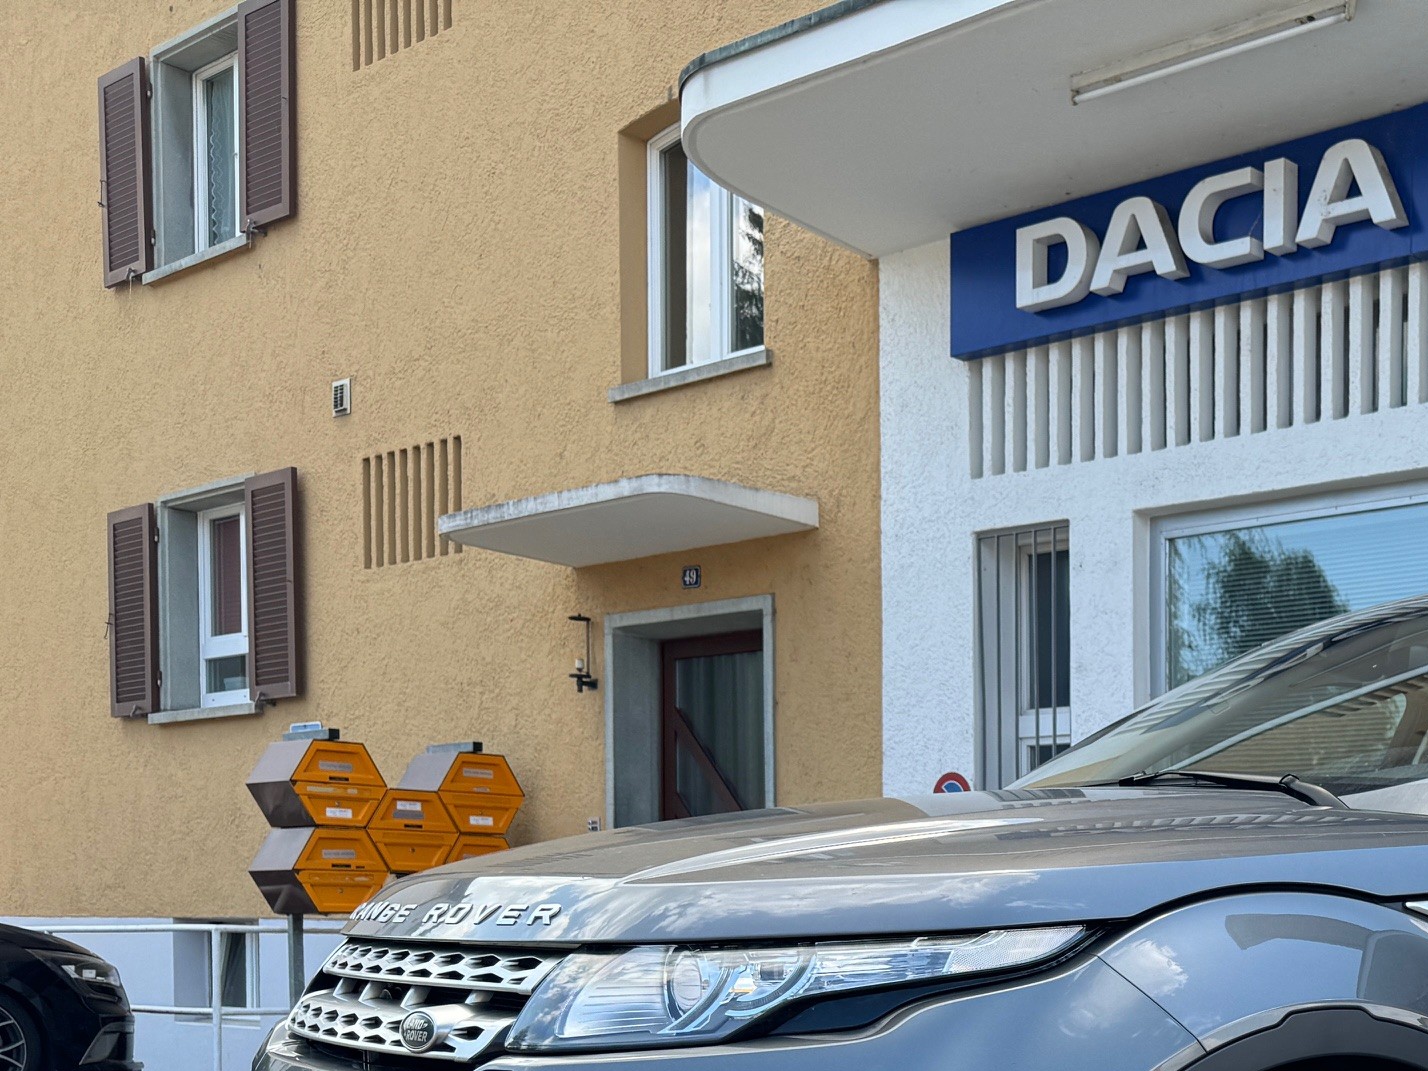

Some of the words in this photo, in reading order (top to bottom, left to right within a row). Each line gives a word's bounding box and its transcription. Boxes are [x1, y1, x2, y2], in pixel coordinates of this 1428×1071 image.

[1016, 138, 1408, 313] DACIA
[684, 569, 697, 585] 49
[421, 903, 562, 926] ROVER
[405, 1030, 428, 1042] ROVER
